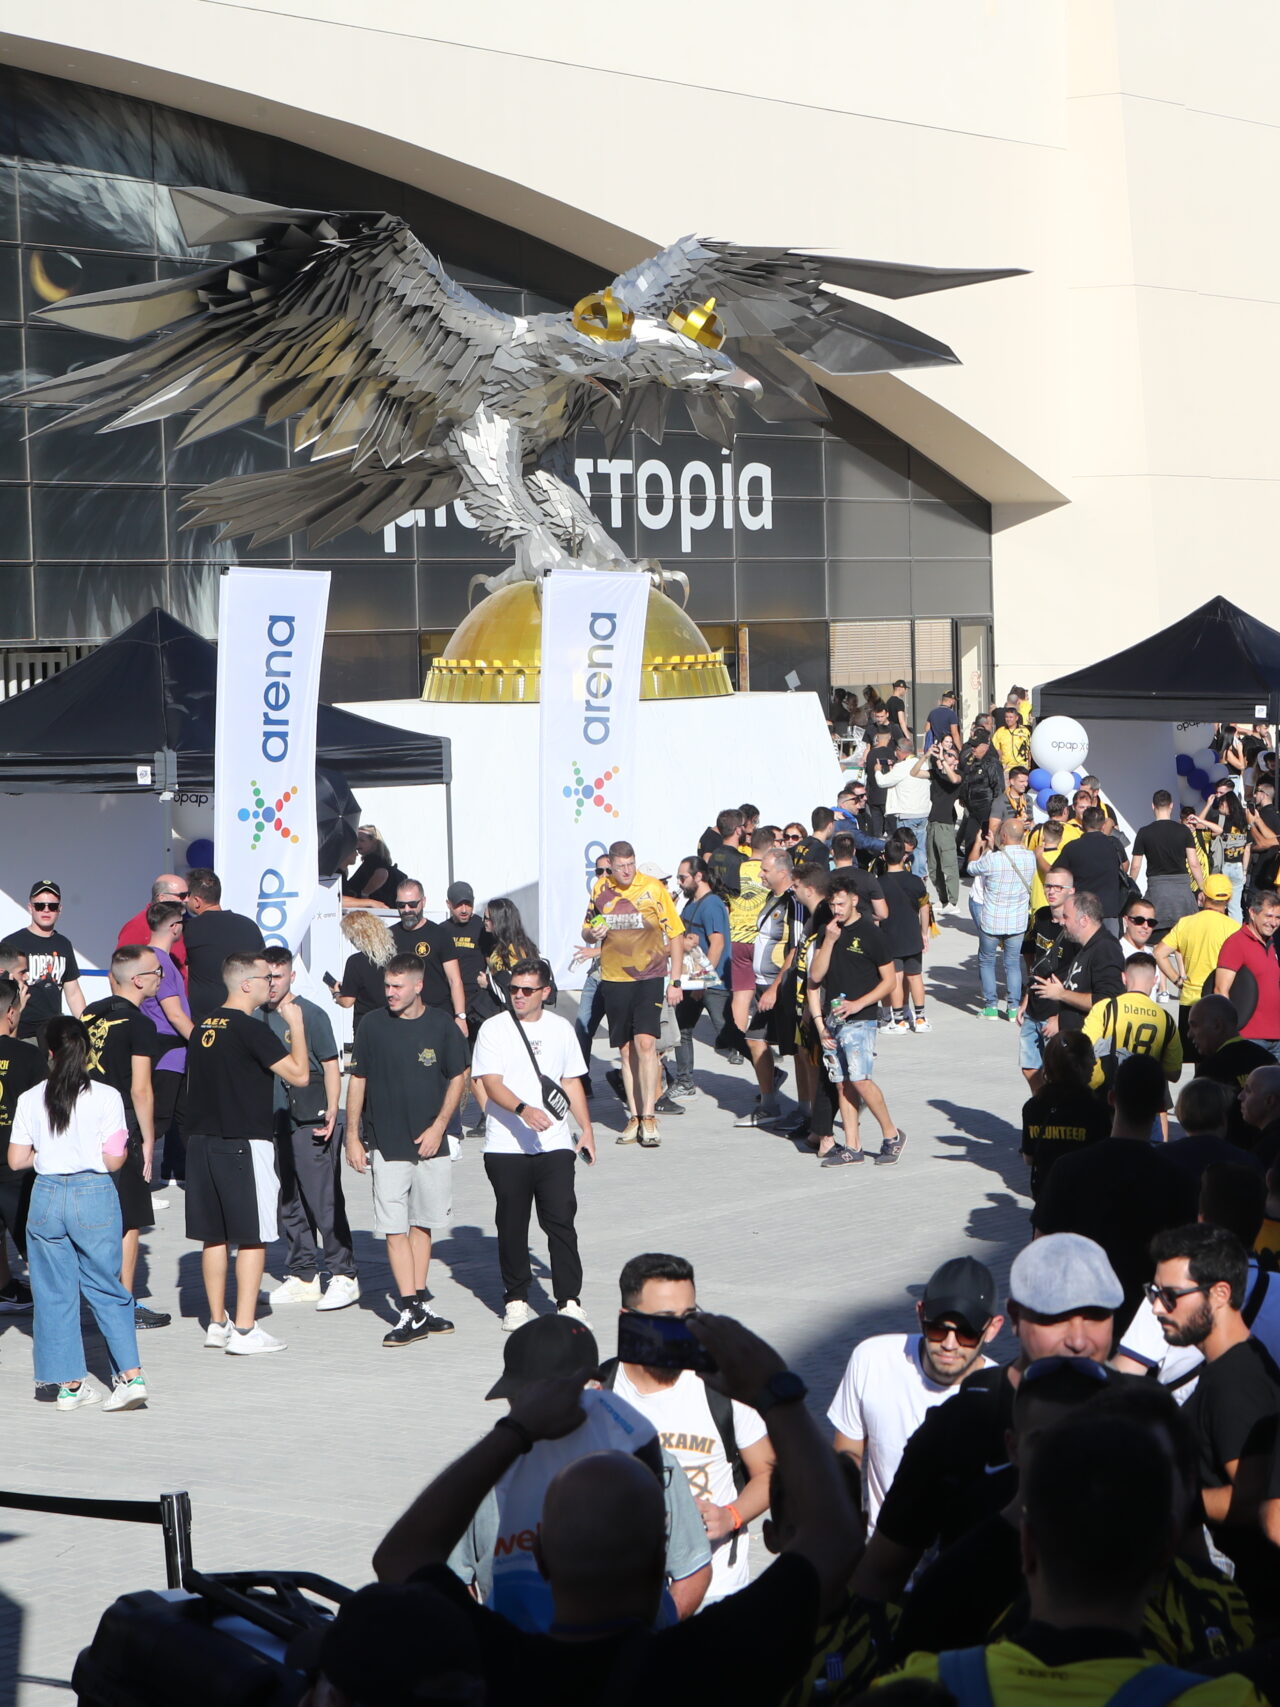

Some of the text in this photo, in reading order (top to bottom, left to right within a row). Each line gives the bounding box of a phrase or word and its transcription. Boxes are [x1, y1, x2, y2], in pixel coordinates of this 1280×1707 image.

[583, 612, 617, 745] arena
[262, 615, 295, 763] arena
[1051, 741, 1079, 752] opap
[173, 793, 208, 808] opap
[1123, 1004, 1158, 1017] blanco
[203, 1018, 230, 1026] AEK
[1122, 1021, 1158, 1055] 18
